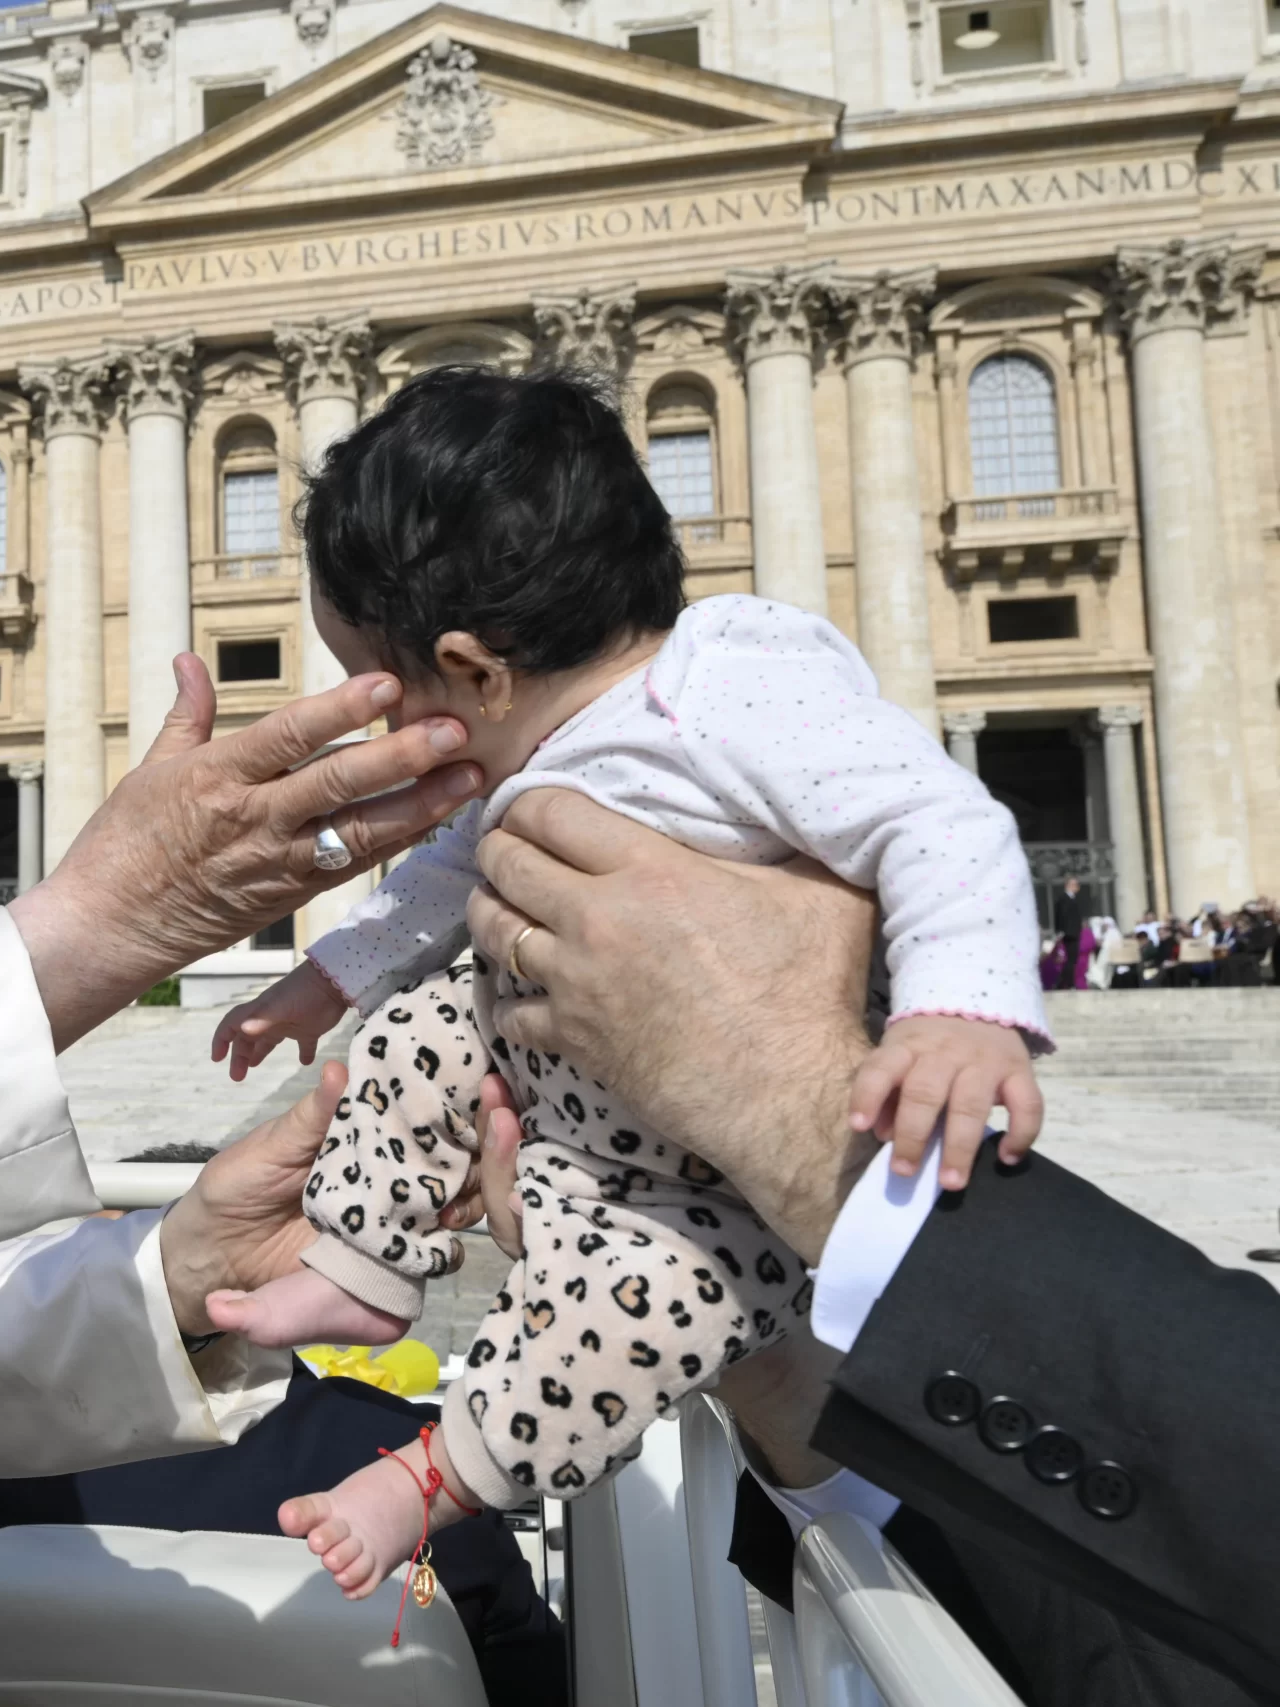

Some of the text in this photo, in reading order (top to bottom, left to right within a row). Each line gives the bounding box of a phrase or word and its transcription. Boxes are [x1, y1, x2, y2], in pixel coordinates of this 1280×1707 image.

[127, 255, 258, 290] PAVLVS
[301, 215, 561, 272] BVRGHESIVS
[574, 188, 801, 241] ROMANVS
[934, 175, 1034, 214] MAX
[1044, 166, 1105, 203] AN
